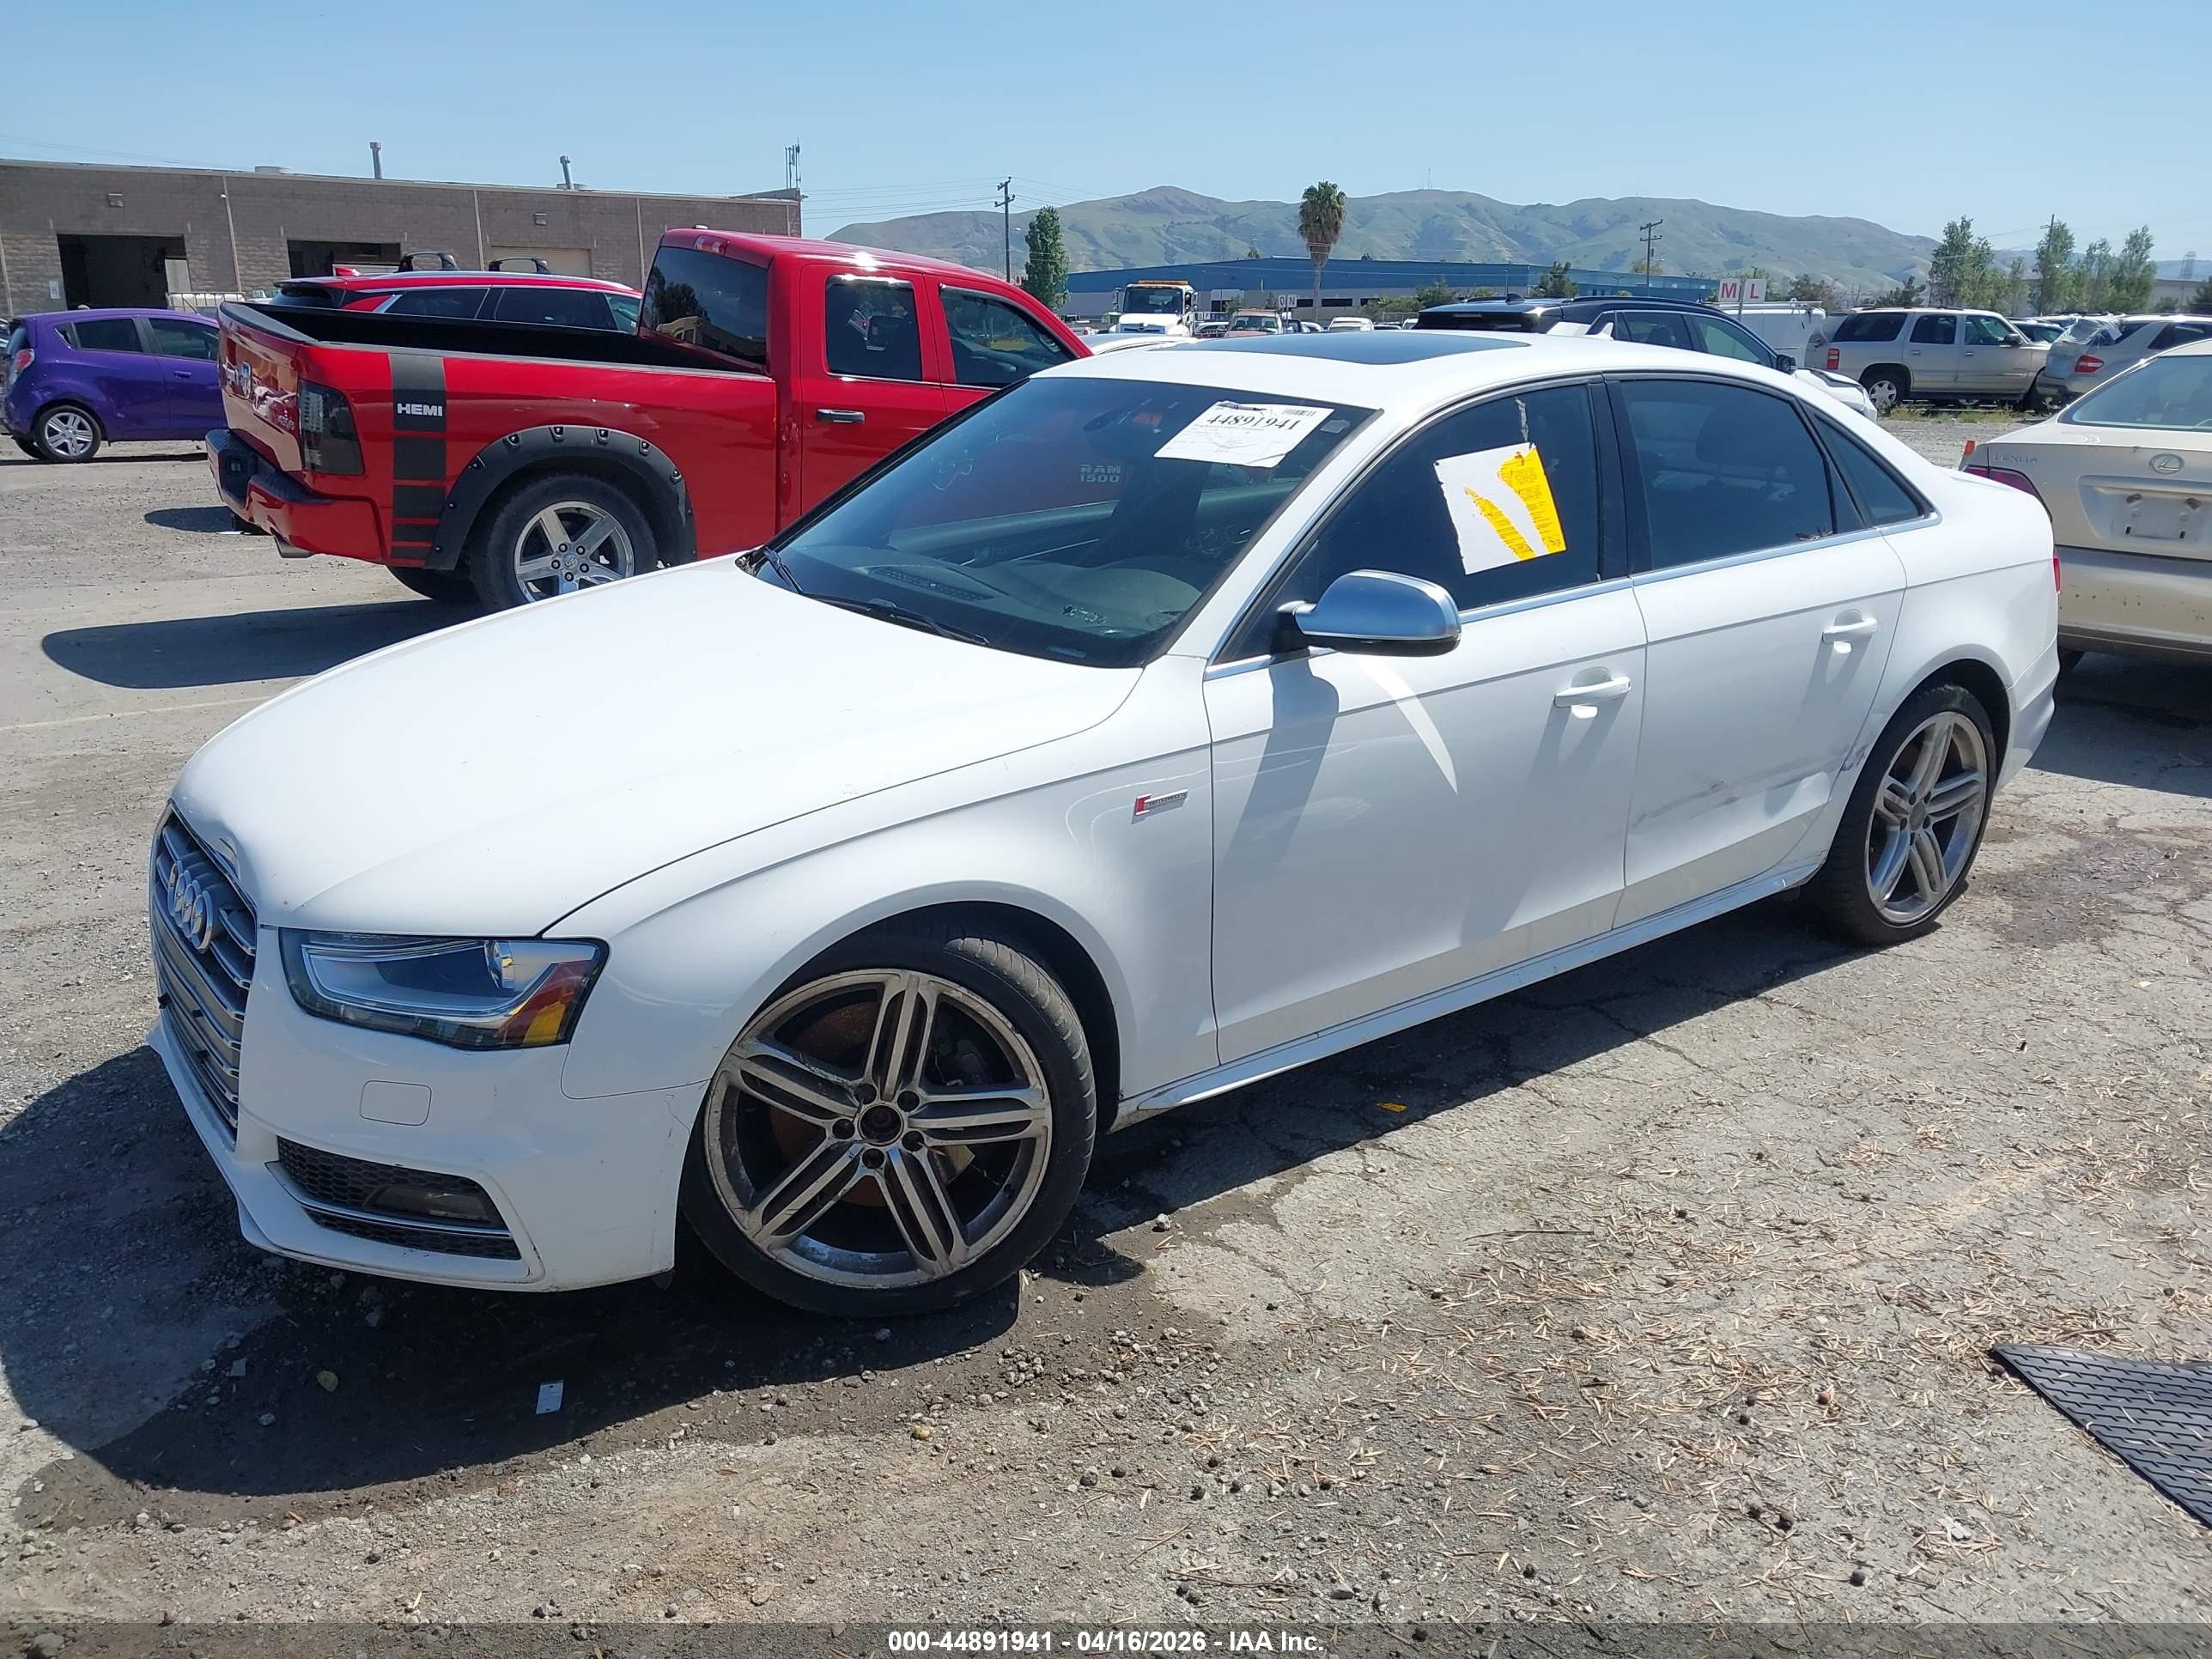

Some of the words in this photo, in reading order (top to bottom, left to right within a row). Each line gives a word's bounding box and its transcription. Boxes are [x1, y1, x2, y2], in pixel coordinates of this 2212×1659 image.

[1721, 283, 1737, 299] M
[1750, 283, 1759, 299] L
[1289, 296, 1296, 306] N
[397, 403, 443, 417] HEMI
[1206, 414, 1303, 430] 44891941
[1993, 453, 2038, 465] LEXUS
[1080, 464, 1121, 474] RAM
[1080, 474, 1120, 483] 1500
